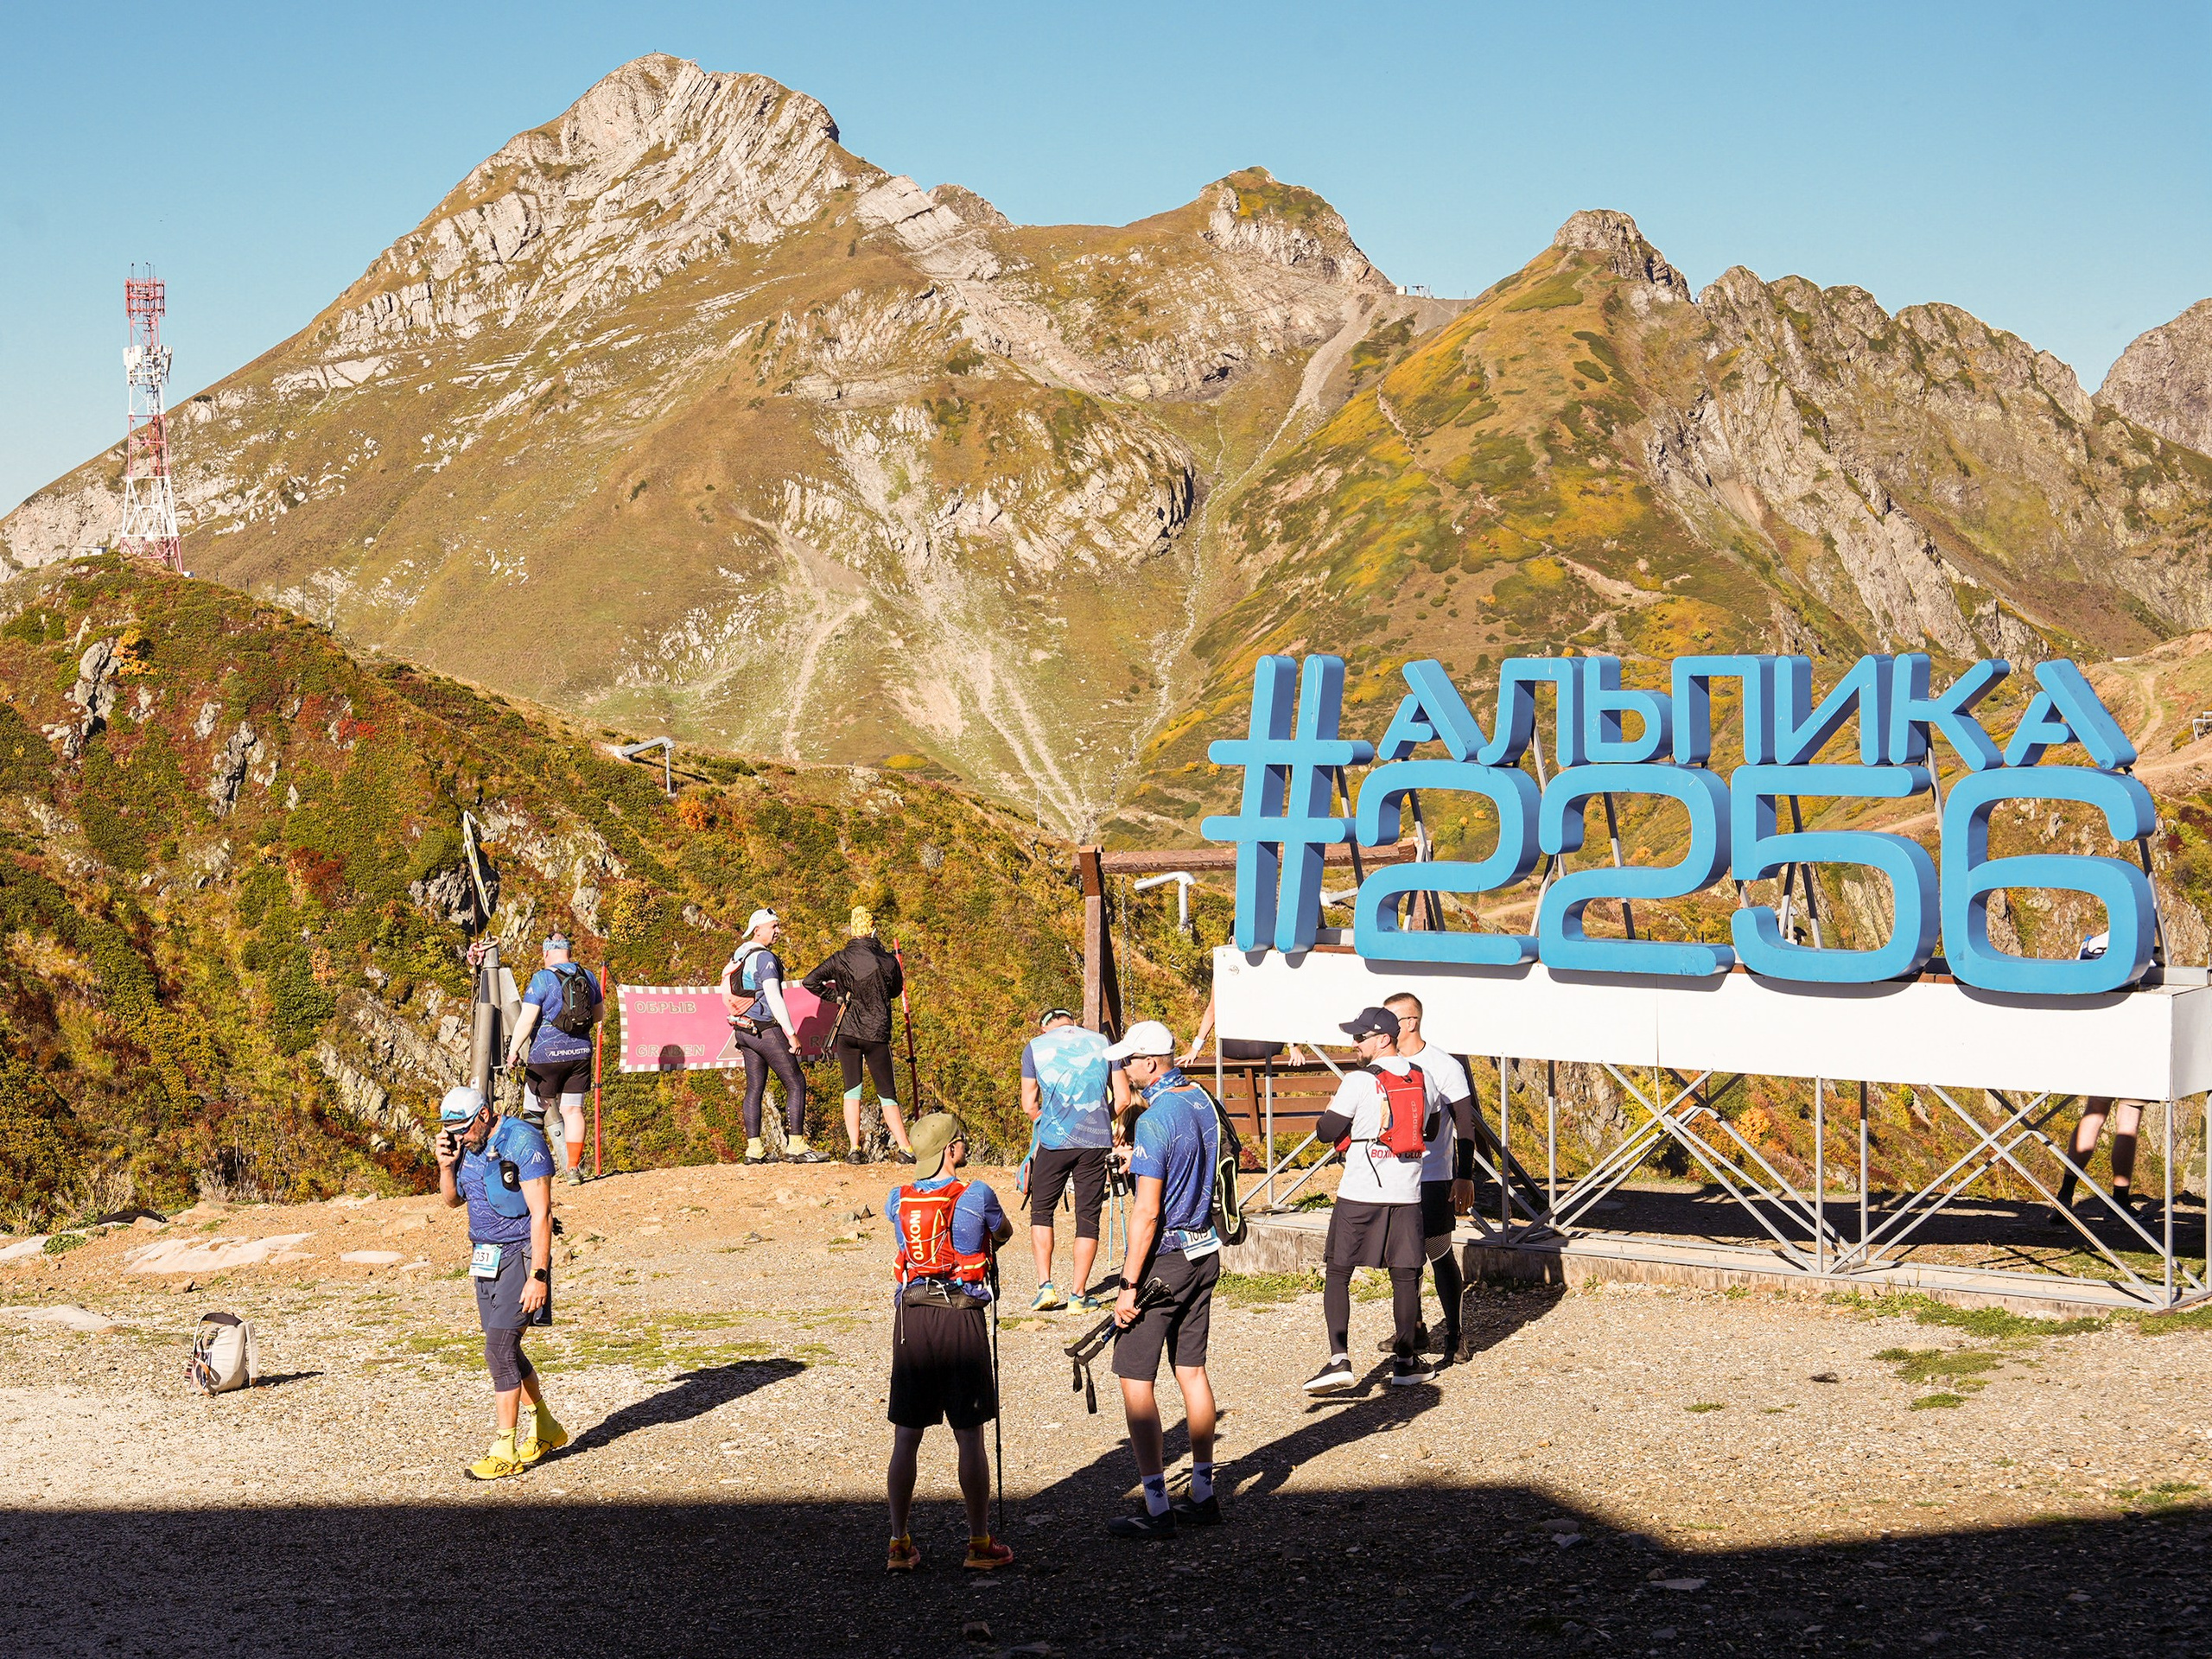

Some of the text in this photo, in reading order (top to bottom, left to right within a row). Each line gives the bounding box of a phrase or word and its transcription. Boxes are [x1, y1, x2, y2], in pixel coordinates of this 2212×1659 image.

[1354, 758, 2156, 995] 2256
[634, 1001, 697, 1014] ОБРЫВ
[636, 1044, 705, 1058] GRABEN
[910, 1210, 924, 1260] INOXTO
[1188, 1227, 1208, 1242] 1019
